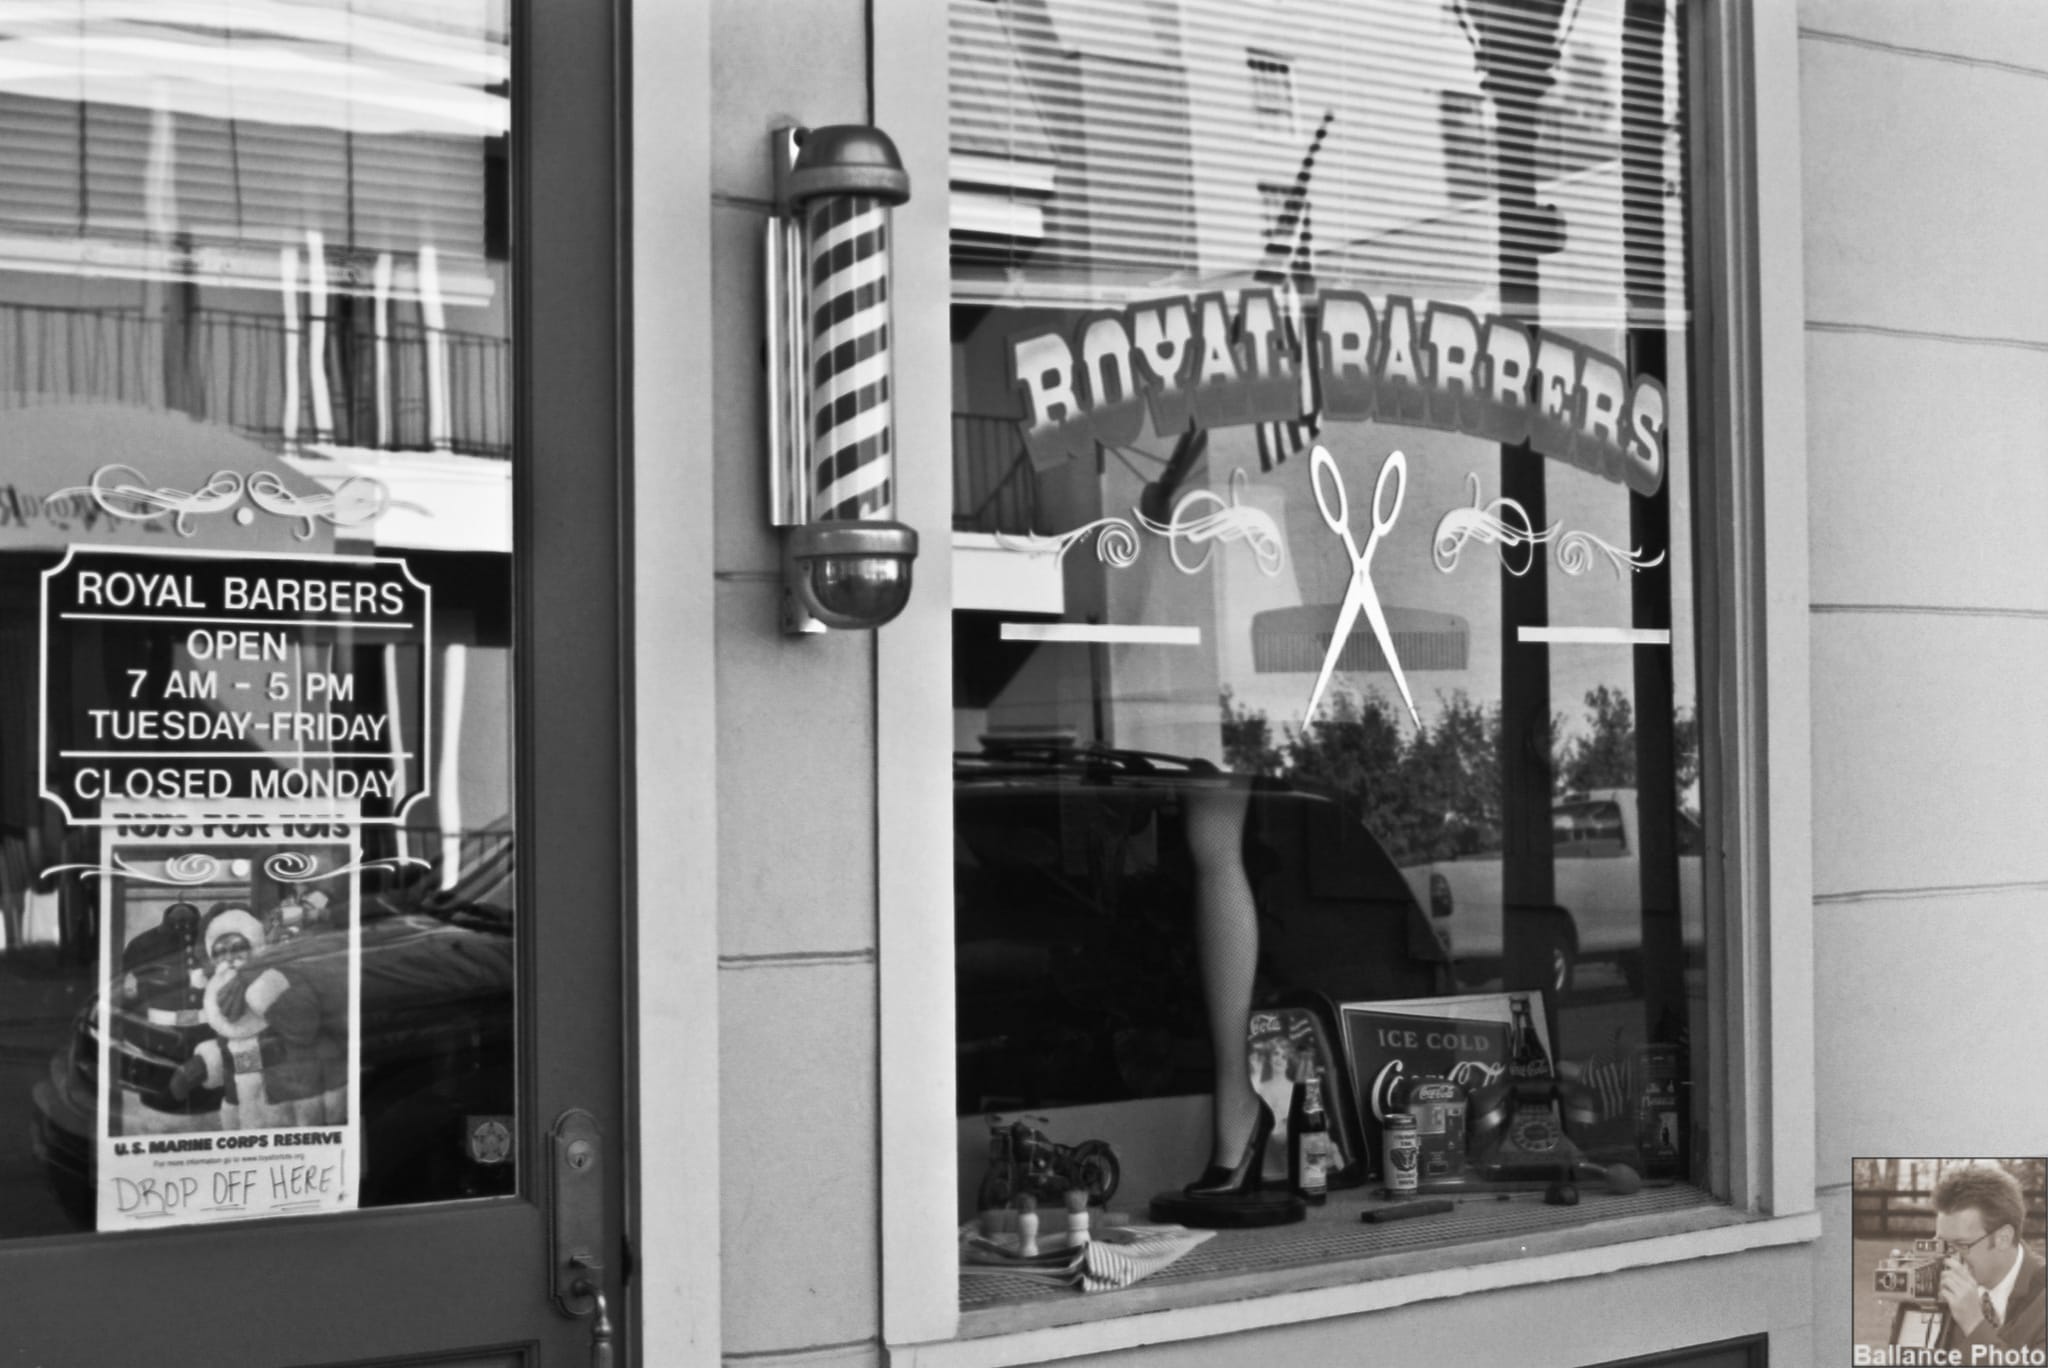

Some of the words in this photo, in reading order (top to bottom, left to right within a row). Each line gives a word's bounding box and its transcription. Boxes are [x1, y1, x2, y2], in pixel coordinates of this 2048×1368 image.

[1006, 288, 1302, 460] ROYAL
[1318, 289, 1667, 492] BARBERS
[77, 571, 206, 609] ROYAL
[223, 576, 404, 616] BARBERS
[186, 629, 288, 661] OPEN
[127, 669, 147, 699] 7
[163, 670, 218, 700] AM
[267, 671, 290, 701] 5
[306, 672, 354, 702] PM
[74, 768, 233, 800] CLOSED
[250, 769, 400, 800] MONDAY
[202, 812, 270, 838] FOR
[1377, 1028, 1418, 1049] ICE
[1426, 1032, 1490, 1052] COLD
[148, 1137, 213, 1154] MARINE
[216, 1134, 269, 1150] CORPS
[273, 1130, 343, 1147] RESERVE
[111, 1175, 199, 1213] DROP
[212, 1169, 258, 1205] OFF
